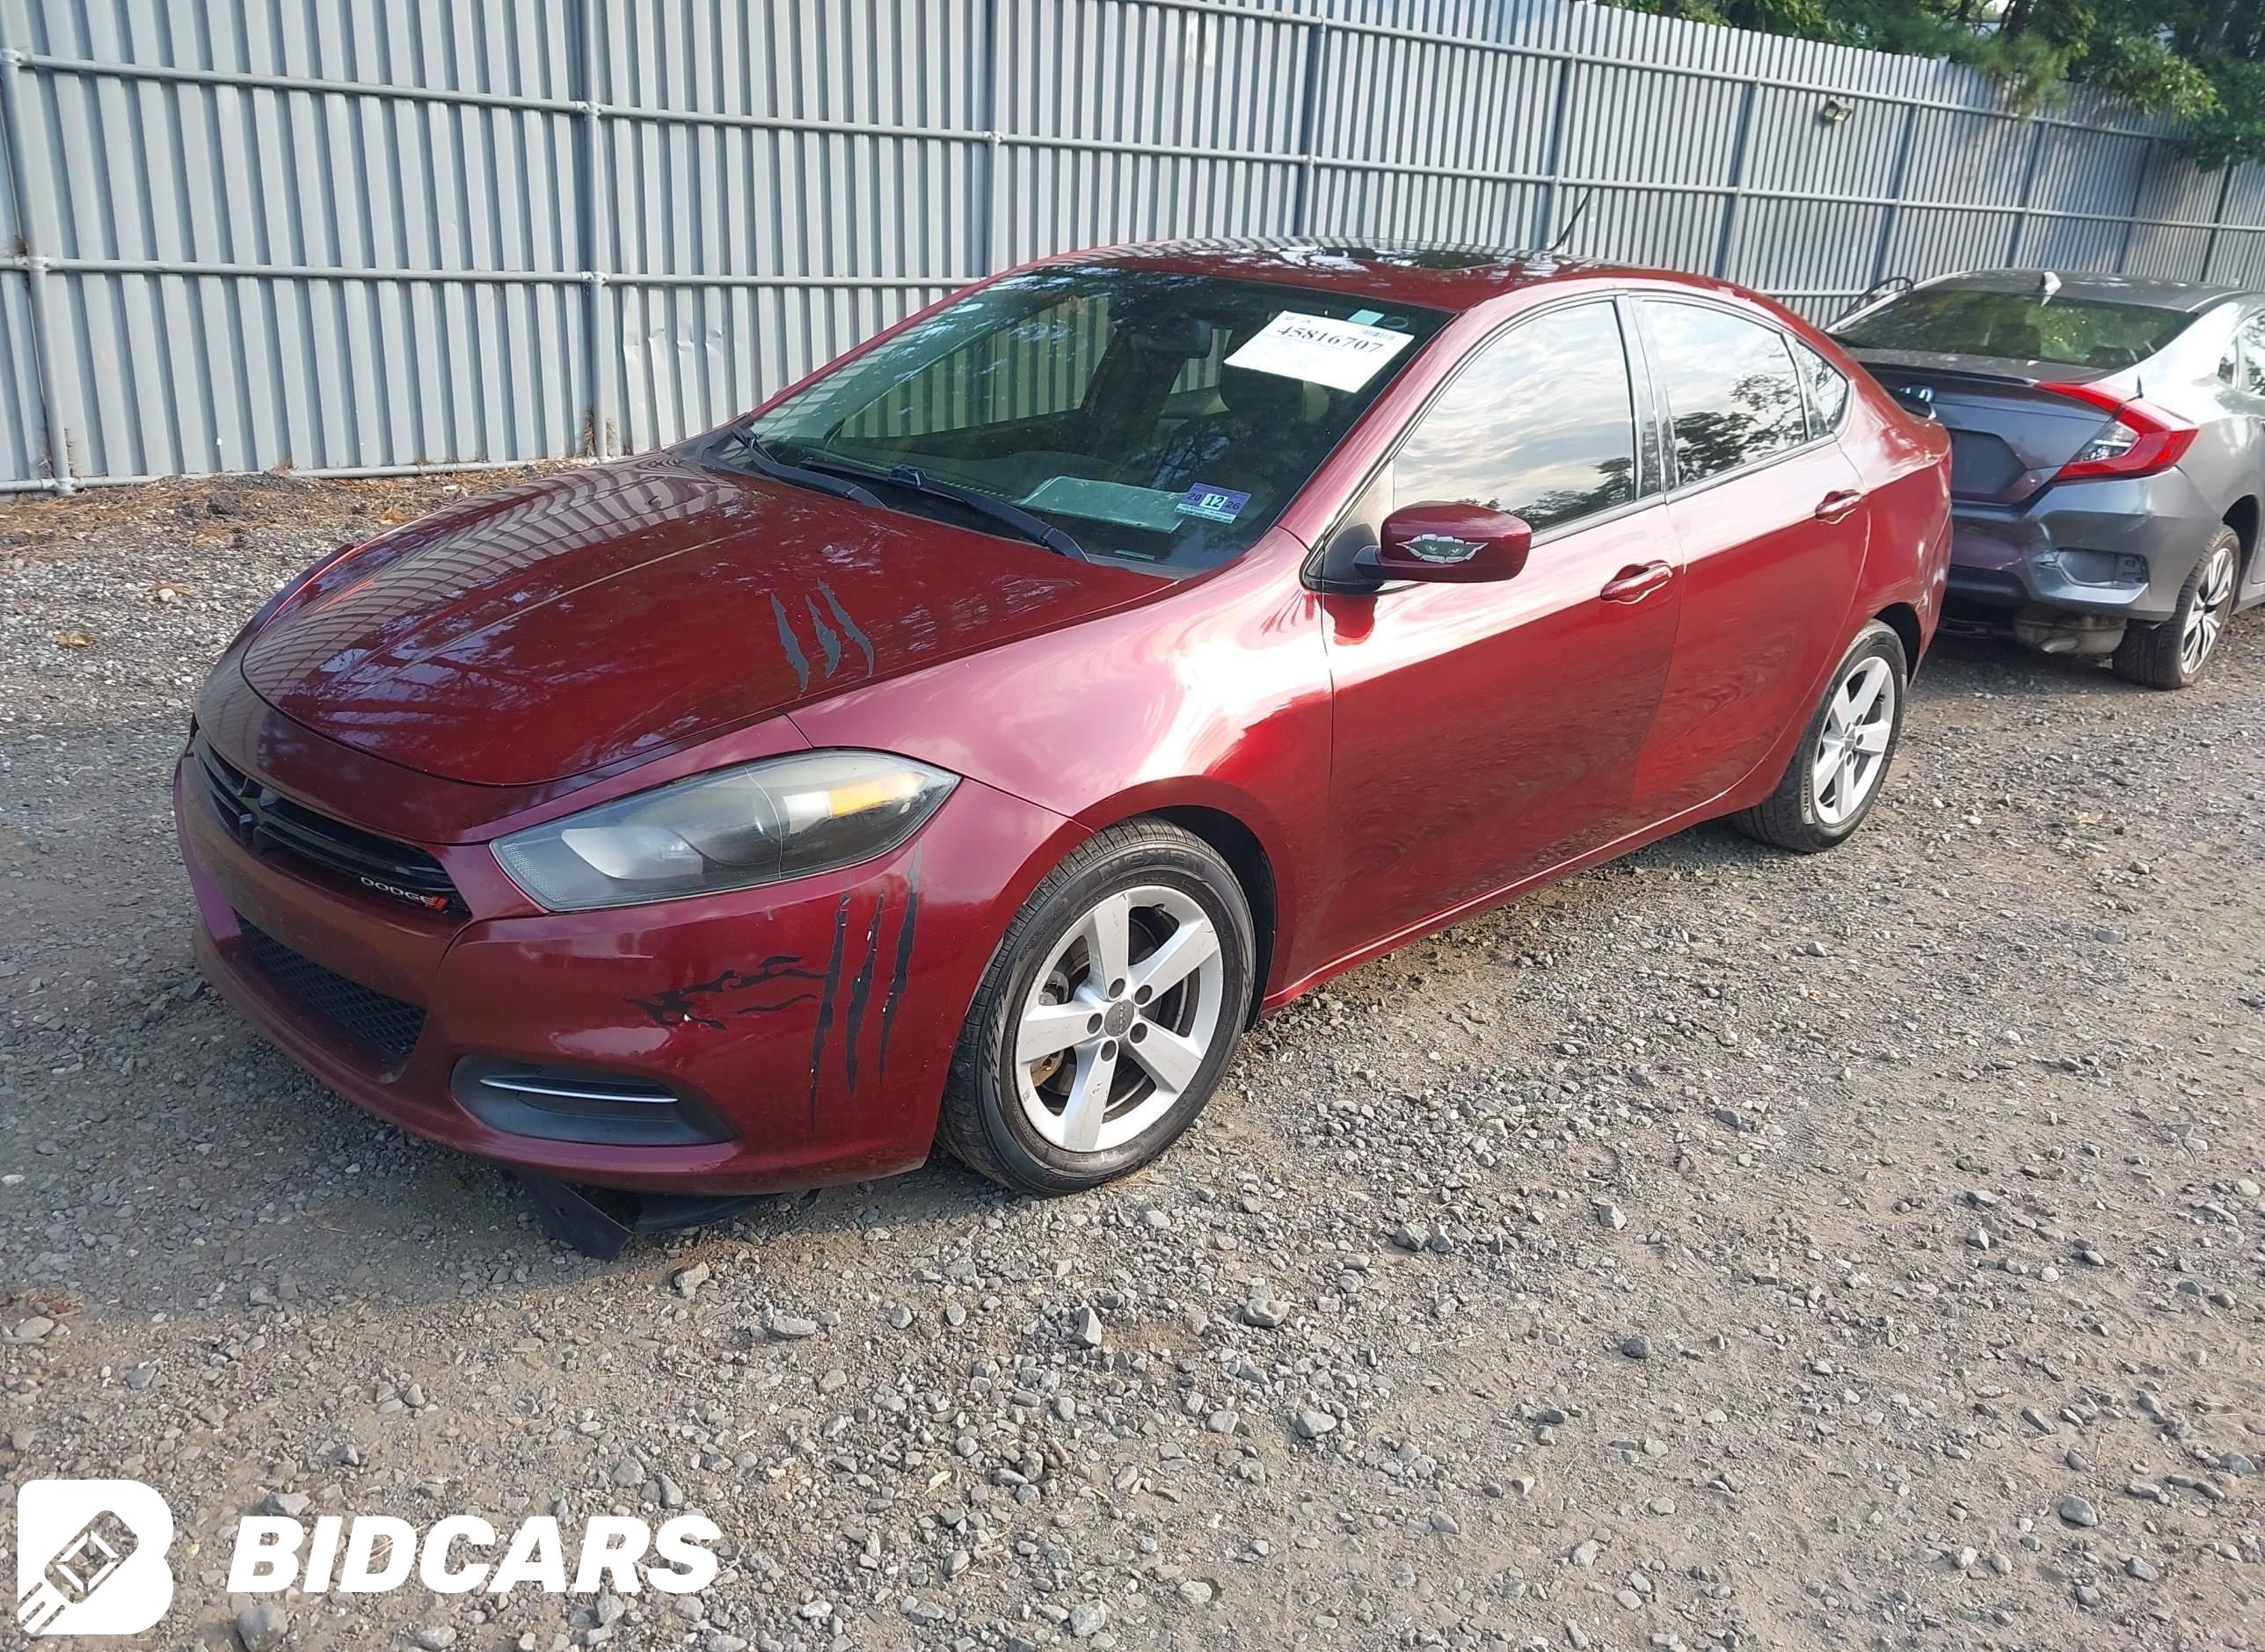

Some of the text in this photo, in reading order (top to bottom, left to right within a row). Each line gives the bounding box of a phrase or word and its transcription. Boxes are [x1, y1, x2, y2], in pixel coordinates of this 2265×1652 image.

[1278, 325, 1385, 353] 45816707
[1187, 492, 1203, 502] 20
[1205, 495, 1225, 508] 12
[1226, 501, 1242, 510] 26
[1098, 848, 1205, 881] NEXEN
[361, 877, 436, 906] DODGE
